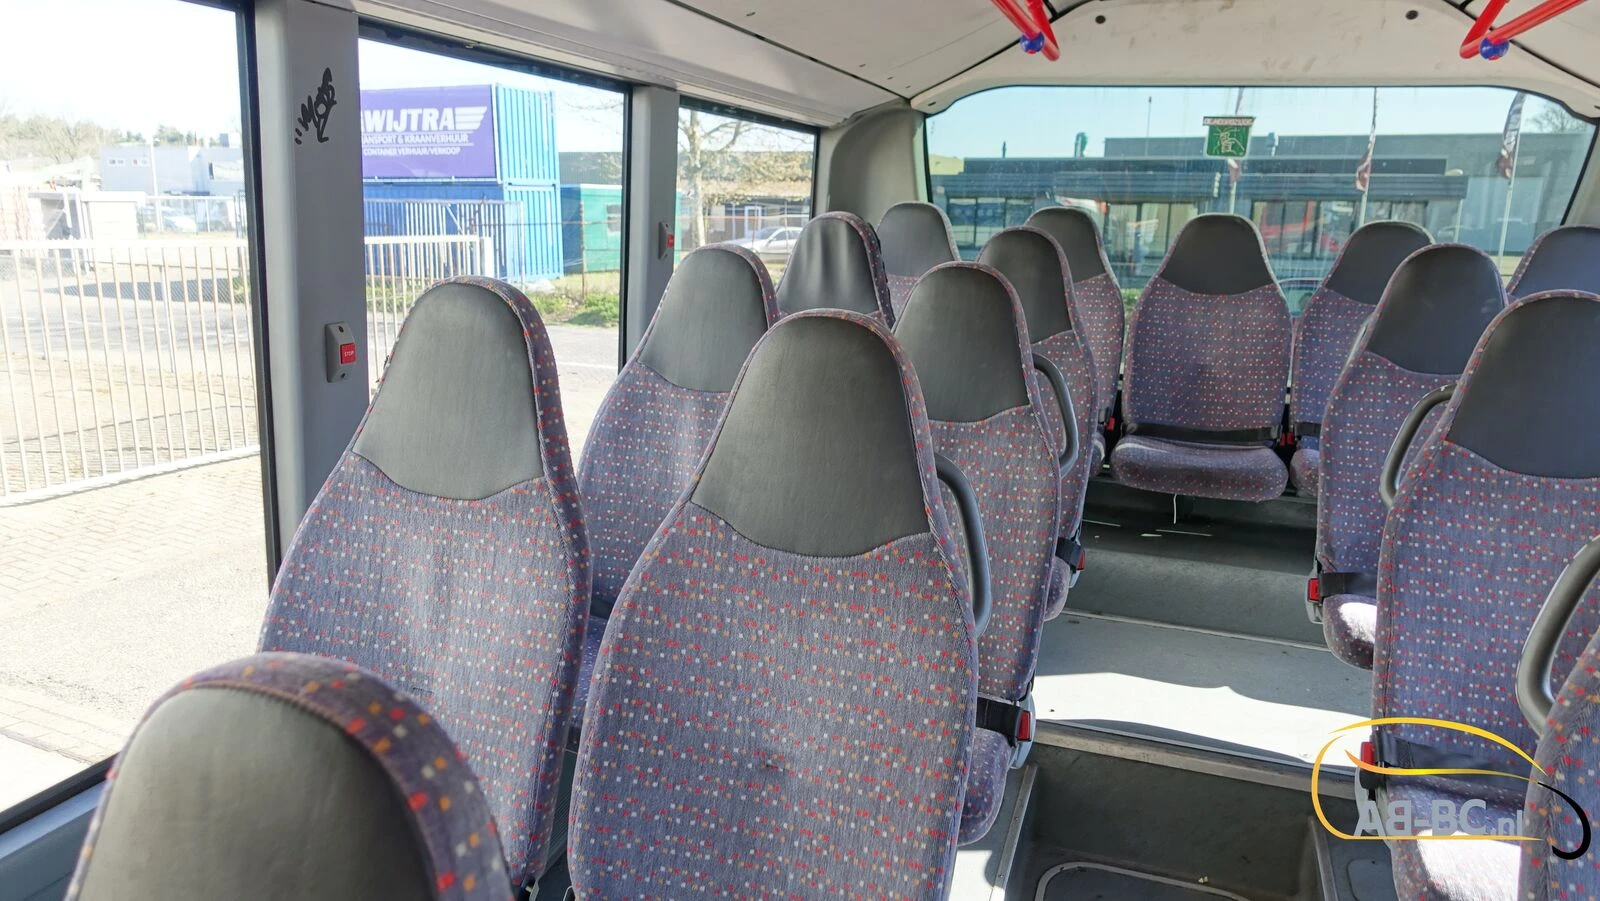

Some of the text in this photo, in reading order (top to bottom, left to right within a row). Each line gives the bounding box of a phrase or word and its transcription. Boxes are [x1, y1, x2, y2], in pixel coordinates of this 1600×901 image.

[361, 107, 455, 132] WIJTRA
[362, 134, 397, 144] ANSPORT
[405, 133, 469, 144] KRAANVERHUUR
